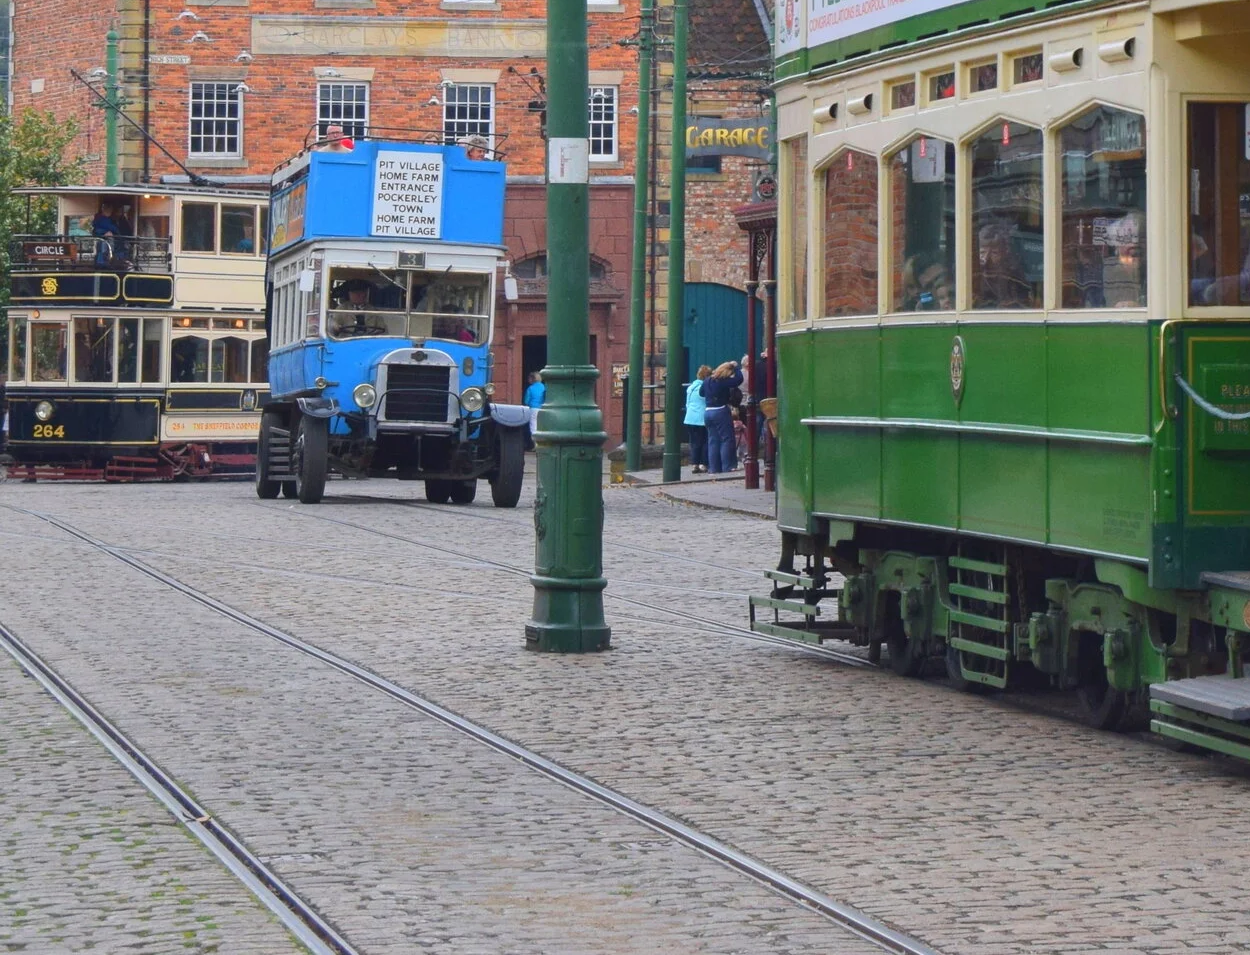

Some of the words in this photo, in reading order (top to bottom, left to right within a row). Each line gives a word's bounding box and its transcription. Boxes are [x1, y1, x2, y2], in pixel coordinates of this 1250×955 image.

[855, 0, 886, 17] BLACKPOOL
[304, 26, 417, 46] BARCLAYS
[448, 29, 508, 48] BANK
[686, 126, 769, 148] GARAGE
[379, 160, 395, 169] PIT
[400, 162, 440, 171] VILLAGE
[380, 172, 408, 181] HOME
[411, 174, 439, 182] FARM
[381, 182, 435, 192] ENTRANCE
[378, 193, 437, 204] POCKERLEY
[393, 204, 423, 213] TOWN
[377, 214, 405, 224] HOME
[408, 216, 436, 225] FARM
[376, 225, 390, 234] PIT
[395, 226, 436, 236] VILLAGE
[35, 246, 65, 255] CIRCLE
[407, 254, 417, 265] 3
[33, 425, 64, 437] 264
[205, 422, 235, 430] SHEFFIELD
